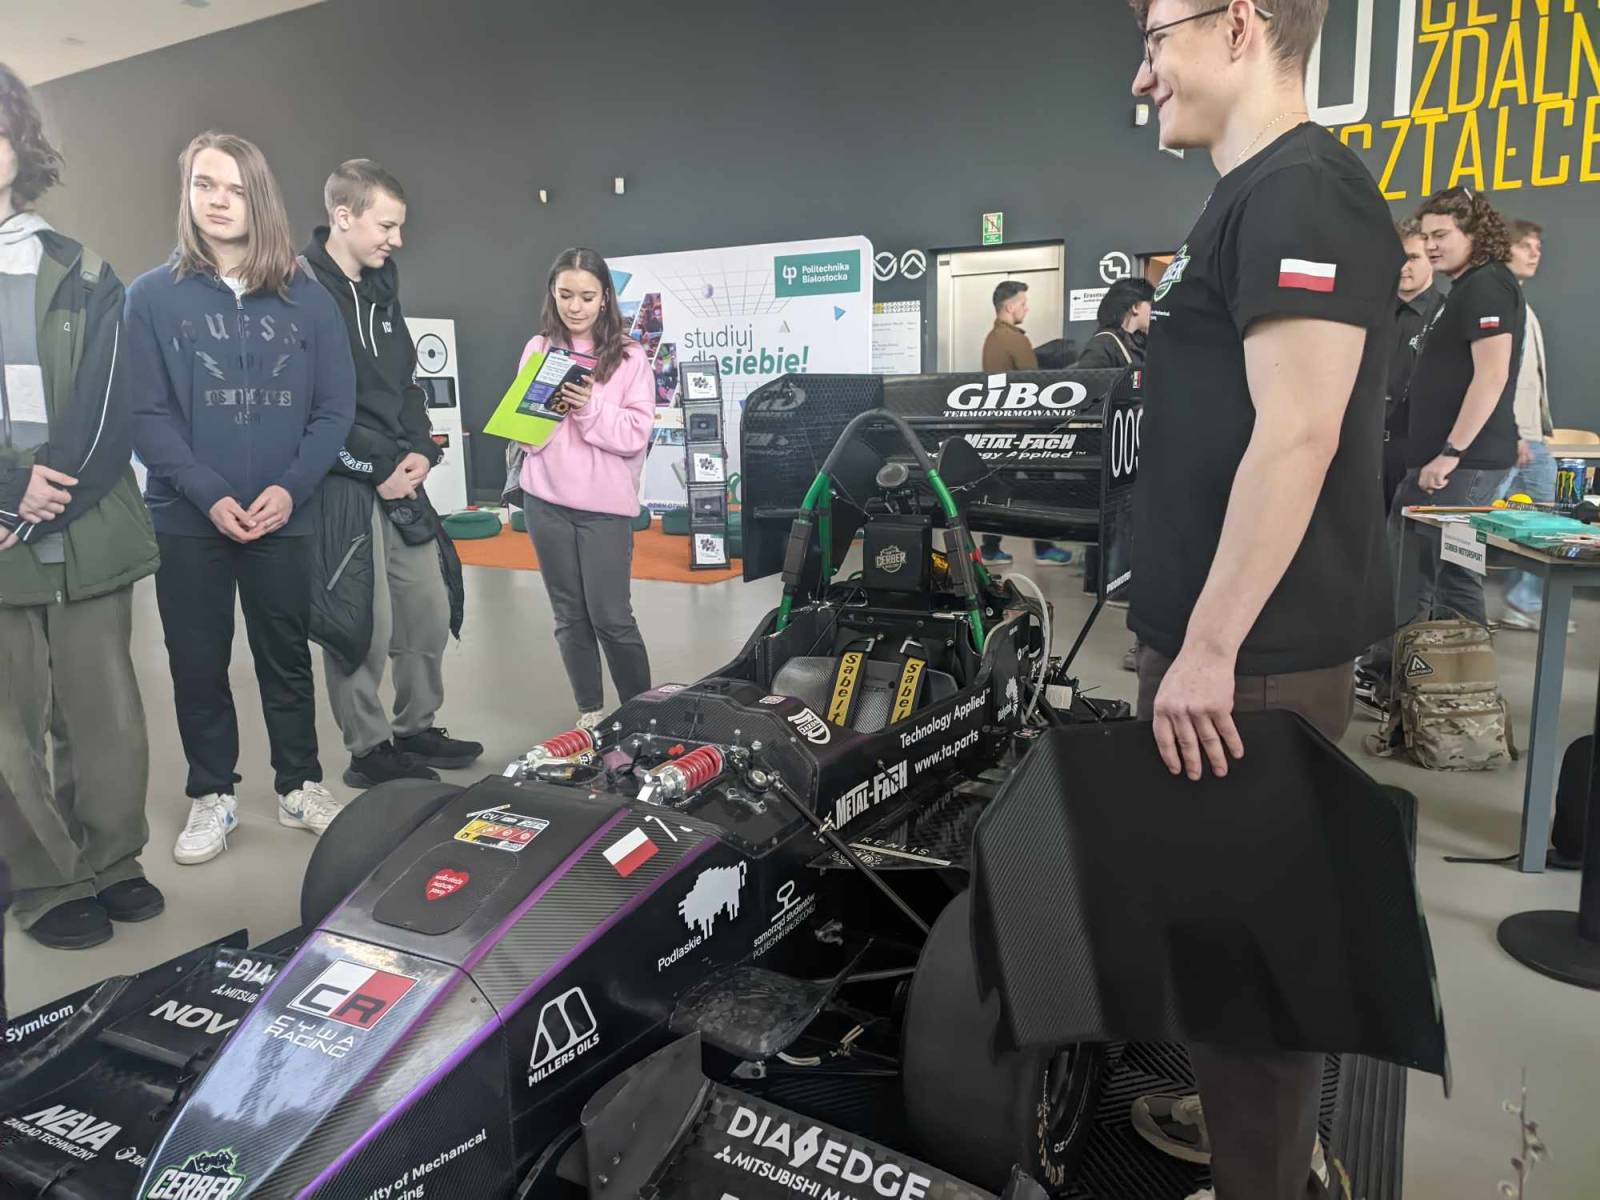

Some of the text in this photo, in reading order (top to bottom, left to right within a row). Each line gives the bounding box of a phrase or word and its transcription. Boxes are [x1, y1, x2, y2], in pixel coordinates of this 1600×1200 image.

[802, 263, 850, 274] Politechnika
[802, 272, 848, 284] Białostocka
[684, 324, 752, 353] studiuj
[721, 346, 809, 375] siebie!
[943, 408, 1076, 418] TERMOFORMOWANIE
[964, 434, 1077, 450] METAL-FACH
[832, 654, 859, 722] Sabelt
[900, 711, 952, 749] Technology
[914, 729, 979, 774] www.ta.parts
[836, 759, 908, 831] METAL-FACH
[658, 935, 702, 972] Podlaskie
[5, 1004, 75, 1043] Symkom
[149, 999, 239, 1035] NOV
[263, 1025, 350, 1058] RACING
[528, 1032, 600, 1087] MILLERS OILS
[22, 1104, 123, 1152] NEVA
[38, 1131, 99, 1161] TECHNICZNY
[394, 1172, 409, 1190] of
[412, 1128, 487, 1180] Mechanical
[731, 1151, 821, 1198] MITSUBISHI
